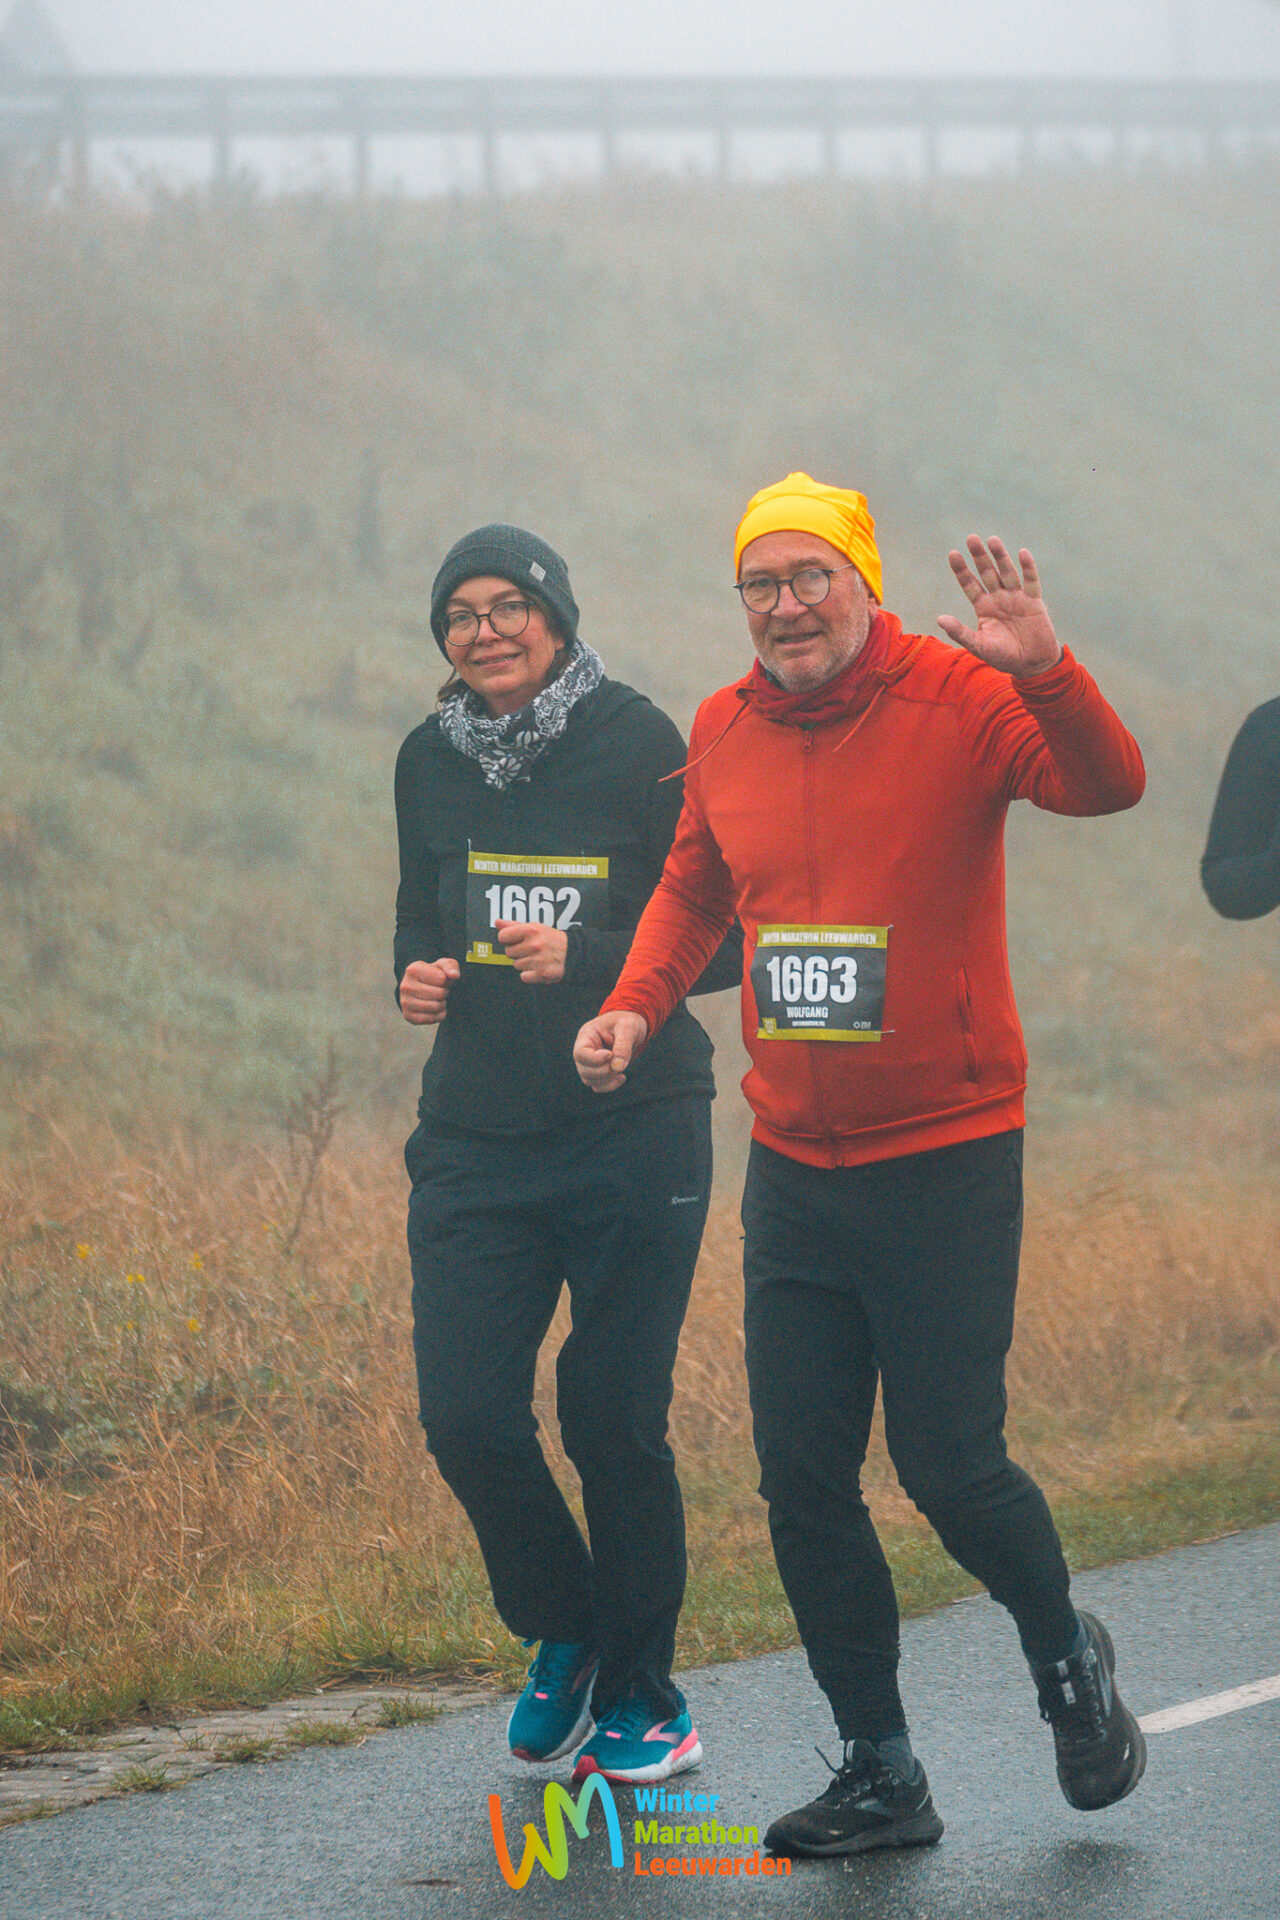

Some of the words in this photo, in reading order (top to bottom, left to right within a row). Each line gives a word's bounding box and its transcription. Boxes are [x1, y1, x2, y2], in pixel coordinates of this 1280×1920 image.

[474, 860, 499, 871] WINTER
[500, 862, 542, 874] MARATHON
[544, 864, 597, 875] LEEUWARDEN
[485, 884, 582, 931] 1662
[781, 932, 819, 943] MARATHON
[821, 933, 876, 944] LEEUWARDEN
[766, 955, 858, 1004] 1663
[787, 1006, 828, 1018] WOLFGANG
